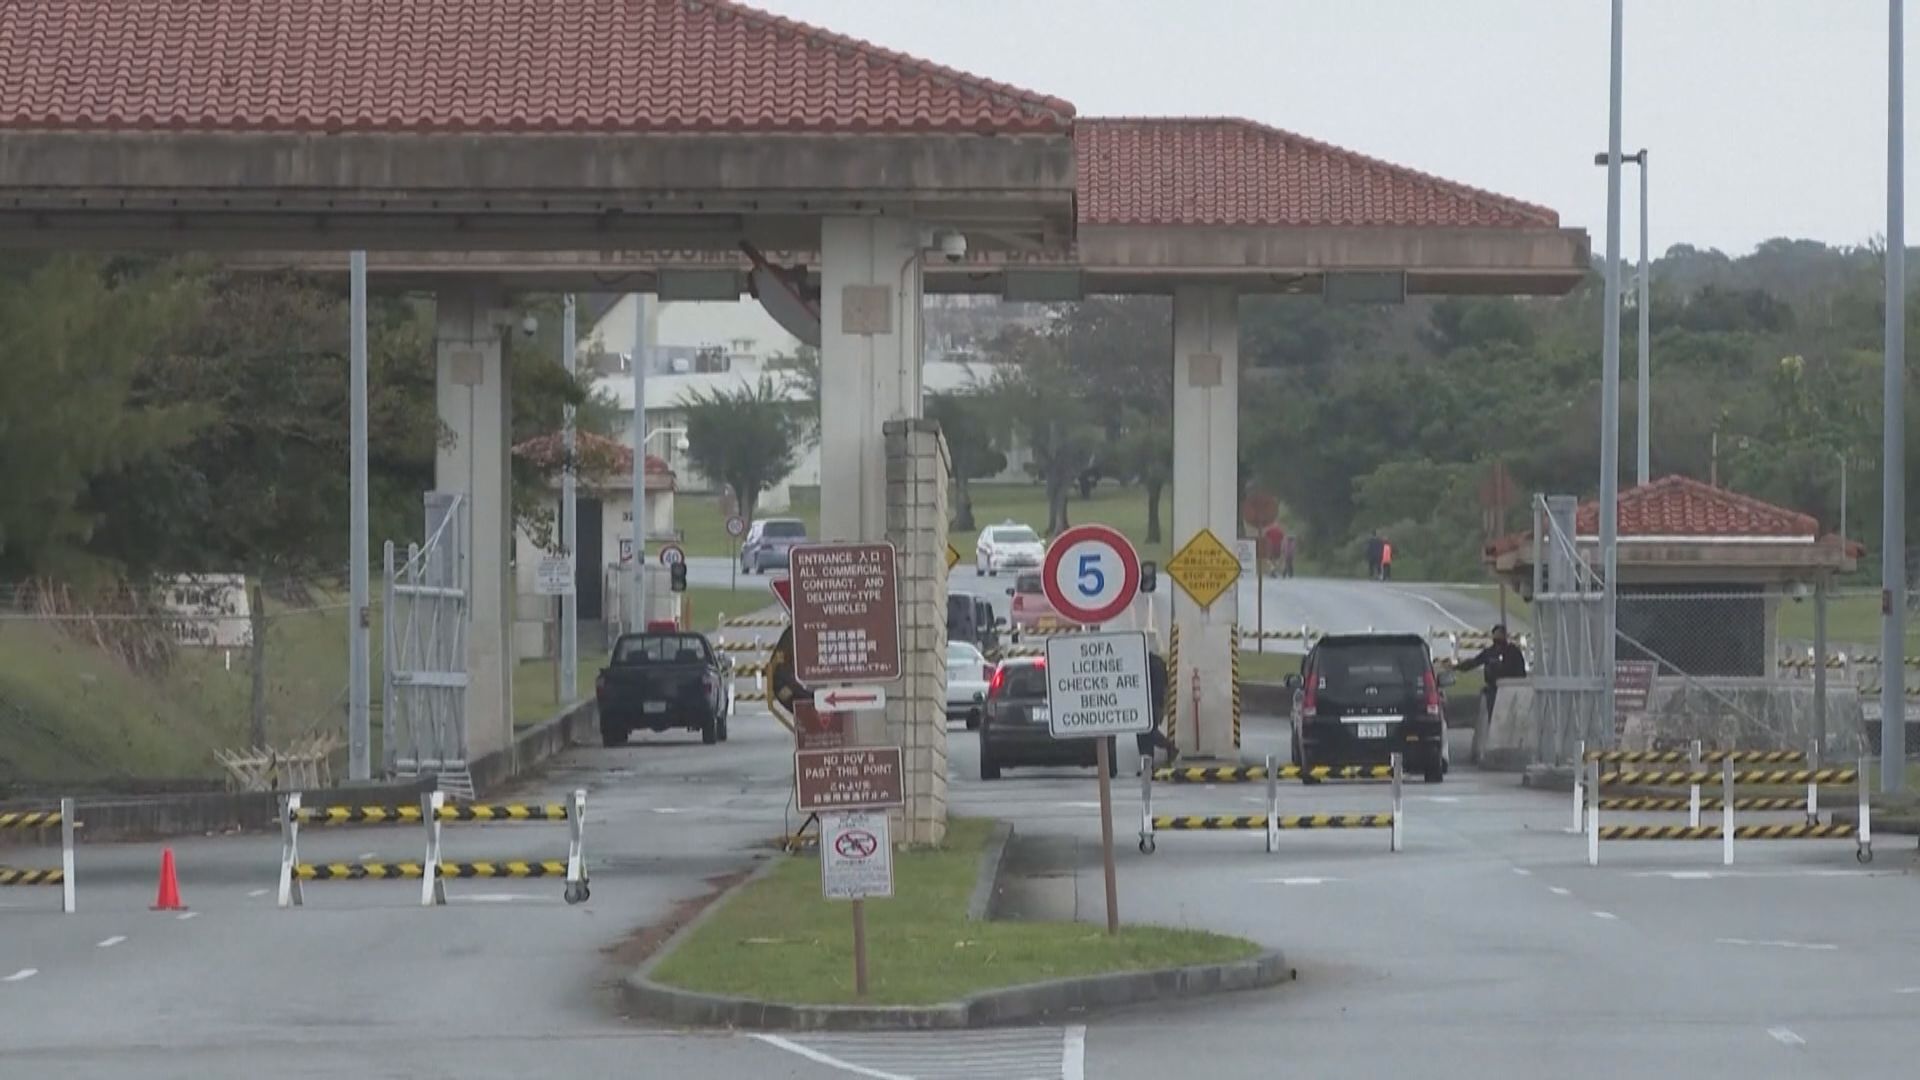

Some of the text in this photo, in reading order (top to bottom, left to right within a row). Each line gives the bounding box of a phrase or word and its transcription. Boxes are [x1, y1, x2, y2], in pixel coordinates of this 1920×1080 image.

[798, 552, 852, 565] ENTRANCE
[800, 567, 817, 578] ALL
[1077, 554, 1105, 597] 5
[802, 577, 884, 590] CONTRACT, AND
[807, 590, 881, 603] DELIVERY-TYPE
[822, 603, 867, 616] VEHICLES
[1080, 641, 1114, 658] SOFA
[1072, 658, 1124, 674] LICENSE
[1058, 674, 1140, 692] CHECKS ARE
[1080, 692, 1118, 709] BEING
[1062, 708, 1139, 727] CONDUCTED
[823, 755, 838, 767] NO
[805, 763, 893, 780] PAST THIS POINT
